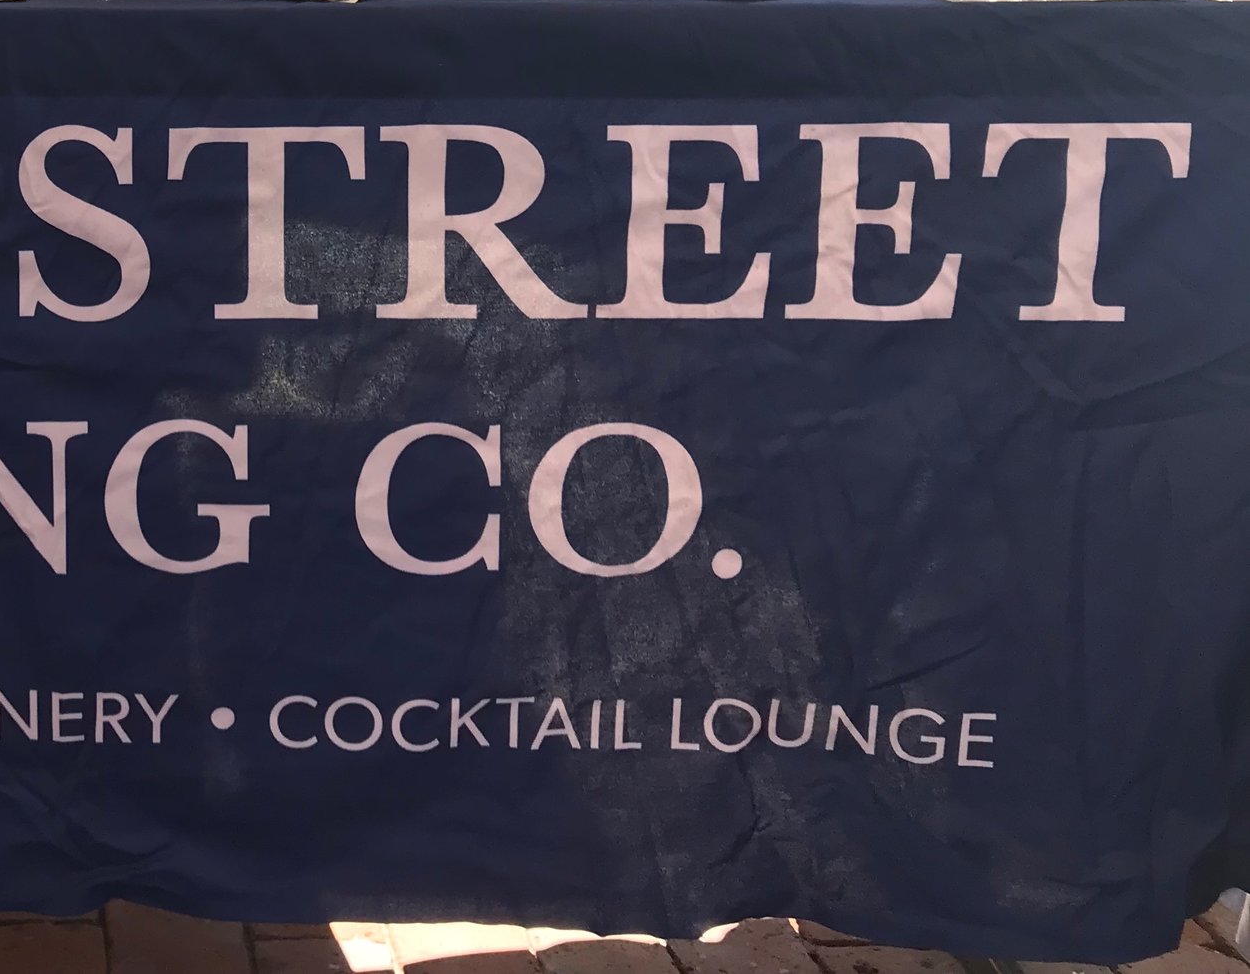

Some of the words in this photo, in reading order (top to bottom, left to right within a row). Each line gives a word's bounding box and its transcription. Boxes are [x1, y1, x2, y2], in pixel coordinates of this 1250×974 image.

[16, 120, 1194, 323] STREET
[353, 420, 745, 580] CO.
[268, 694, 643, 754] COCKTAIL
[668, 697, 999, 770] LOUNGE
